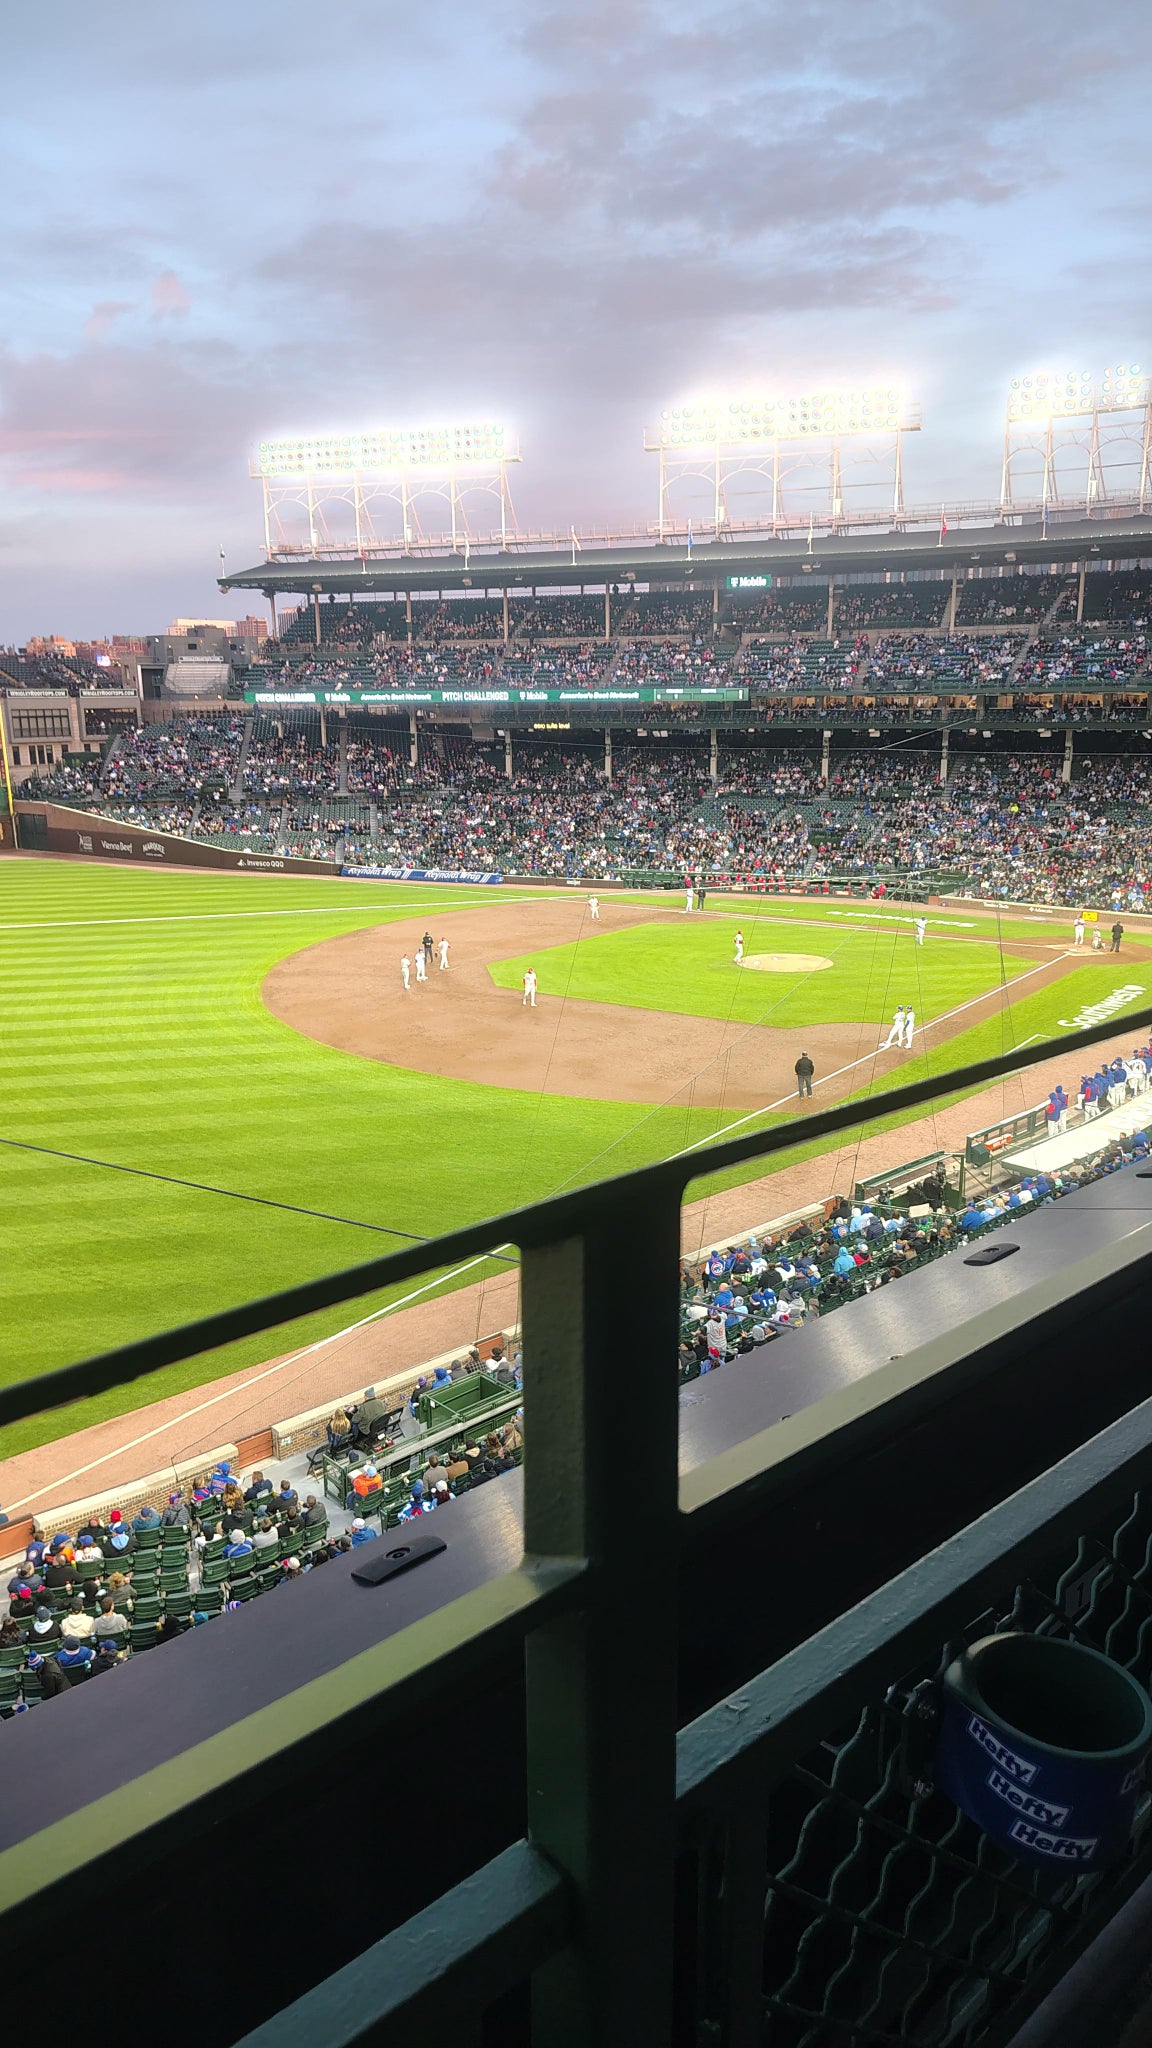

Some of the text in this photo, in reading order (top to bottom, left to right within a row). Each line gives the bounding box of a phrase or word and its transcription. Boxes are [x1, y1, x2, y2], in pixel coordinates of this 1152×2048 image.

[739, 576, 767, 587] Mobile
[442, 691, 509, 702] PITCH CHALLENGED
[526, 691, 548, 701] Mobile
[100, 839, 120, 851] Vienna
[119, 841, 133, 854] Beef
[246, 859, 284, 868] Invesco QQQ
[347, 867, 402, 879] Reynolds Wrap
[424, 870, 482, 882] Reynolds Wrap
[1056, 987, 1145, 1030] Southwest
[971, 1721, 1031, 1780] Hefty
[991, 1773, 1065, 1824] Hefty
[1015, 1823, 1094, 1859] Hefty
